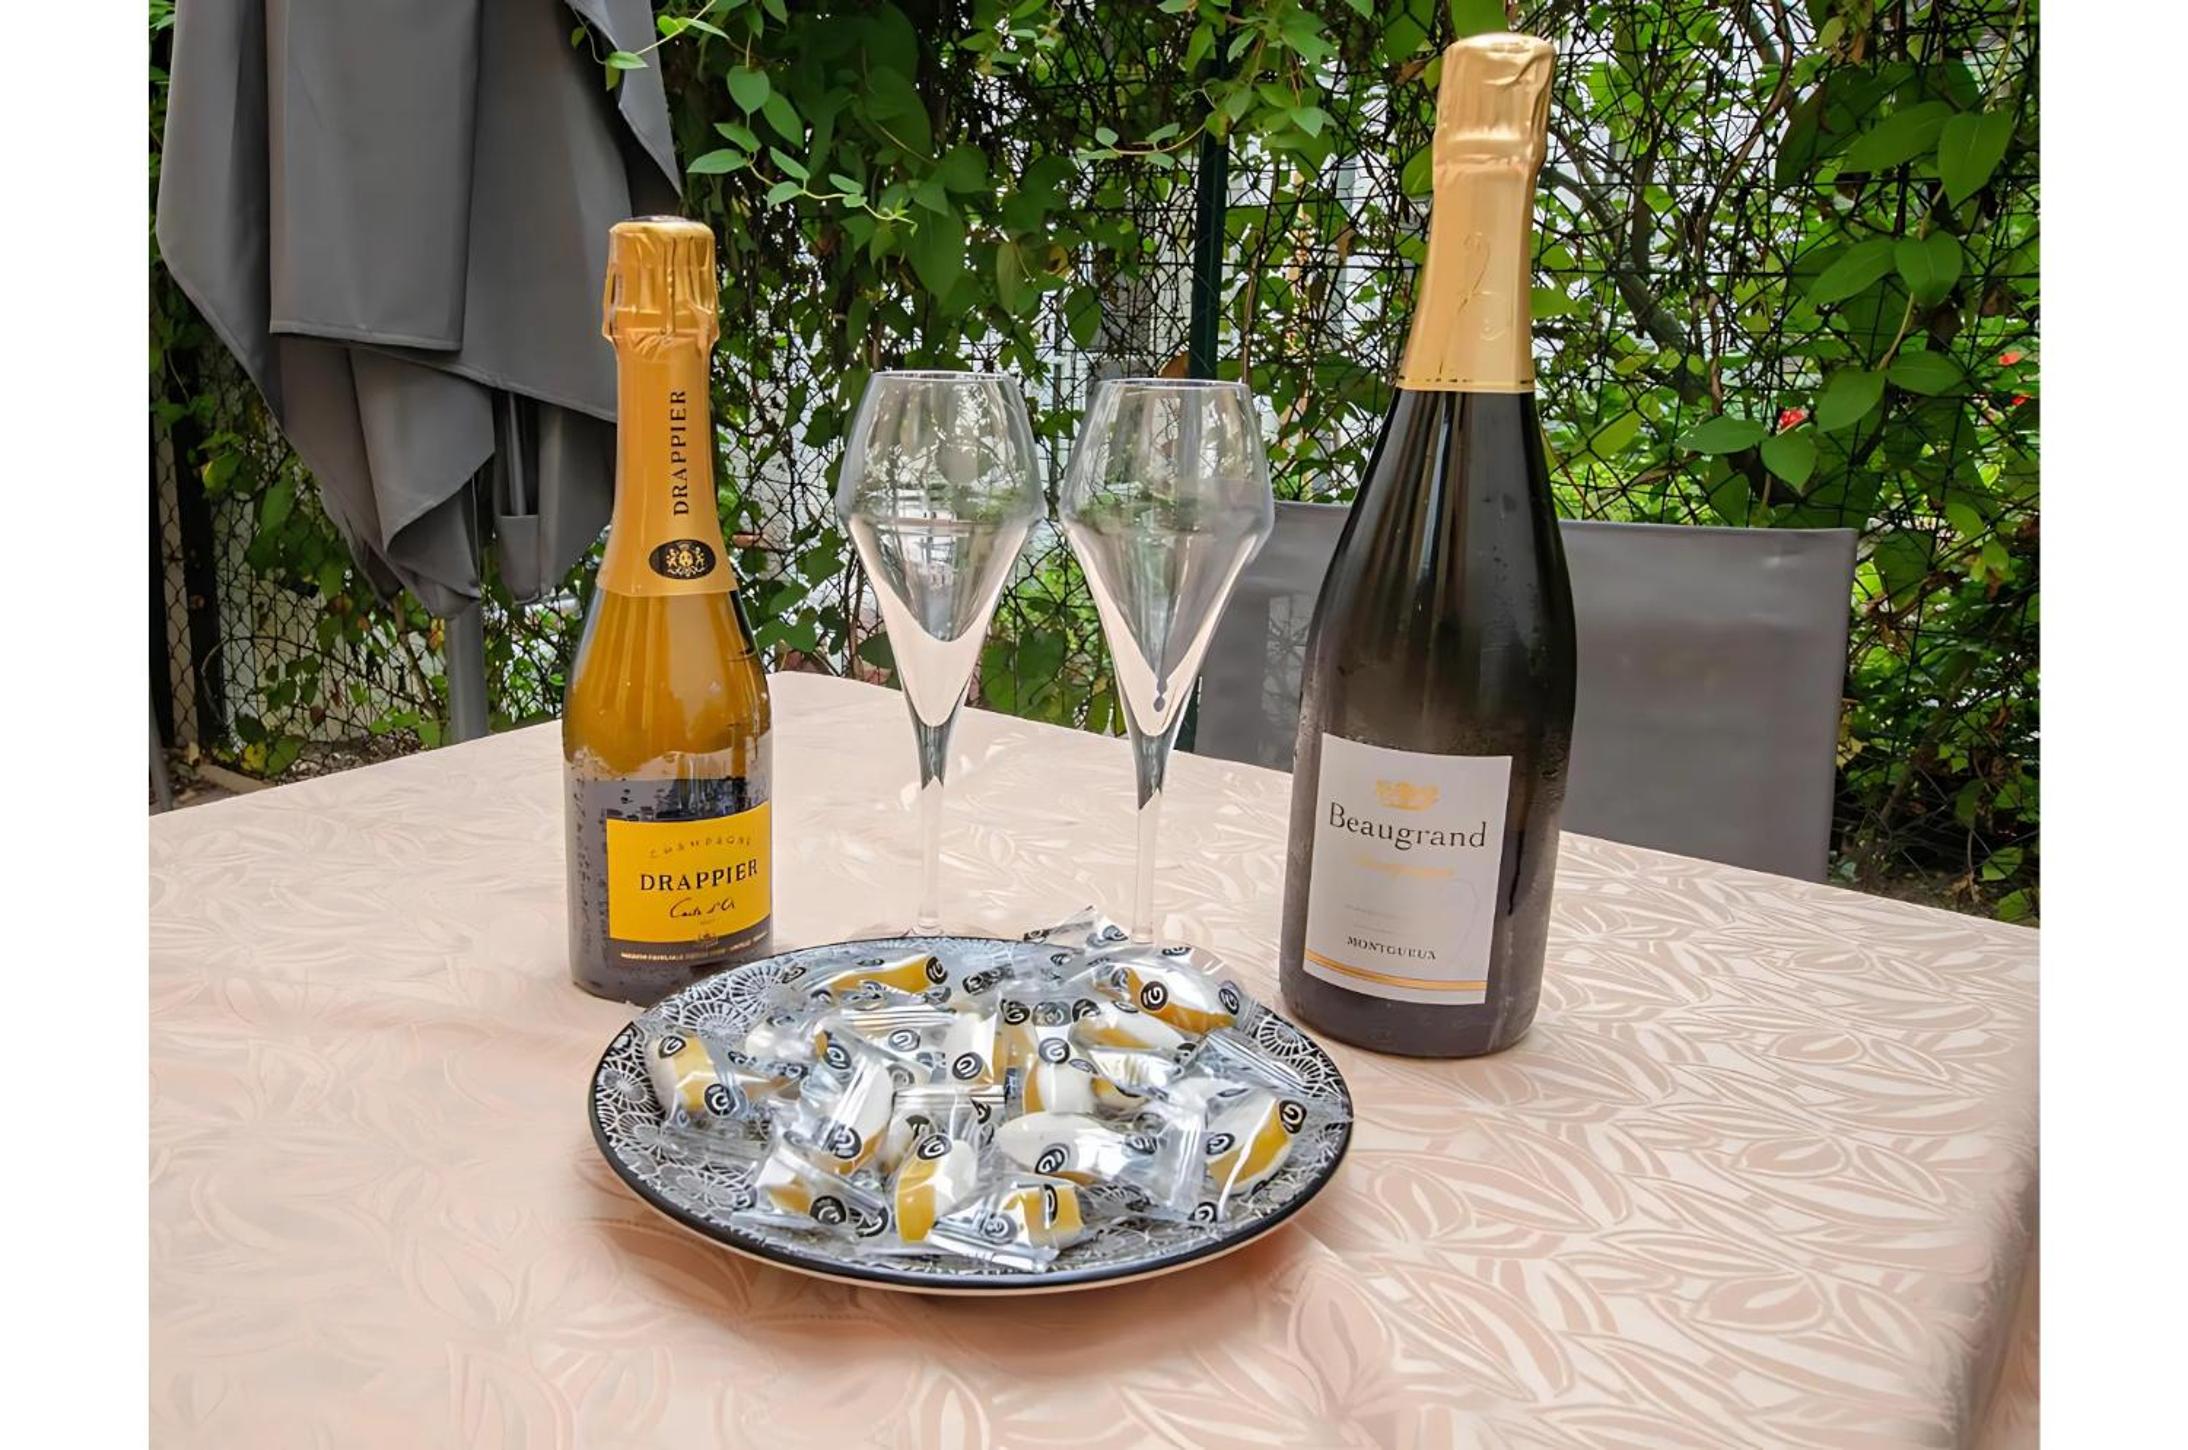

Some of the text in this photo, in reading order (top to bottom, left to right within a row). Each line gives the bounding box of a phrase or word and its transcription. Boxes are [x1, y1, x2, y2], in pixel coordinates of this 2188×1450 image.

[670, 391, 689, 515] DRAPPIER
[1329, 801, 1487, 851] Beaugrand
[641, 858, 758, 891] DRAPPIER
